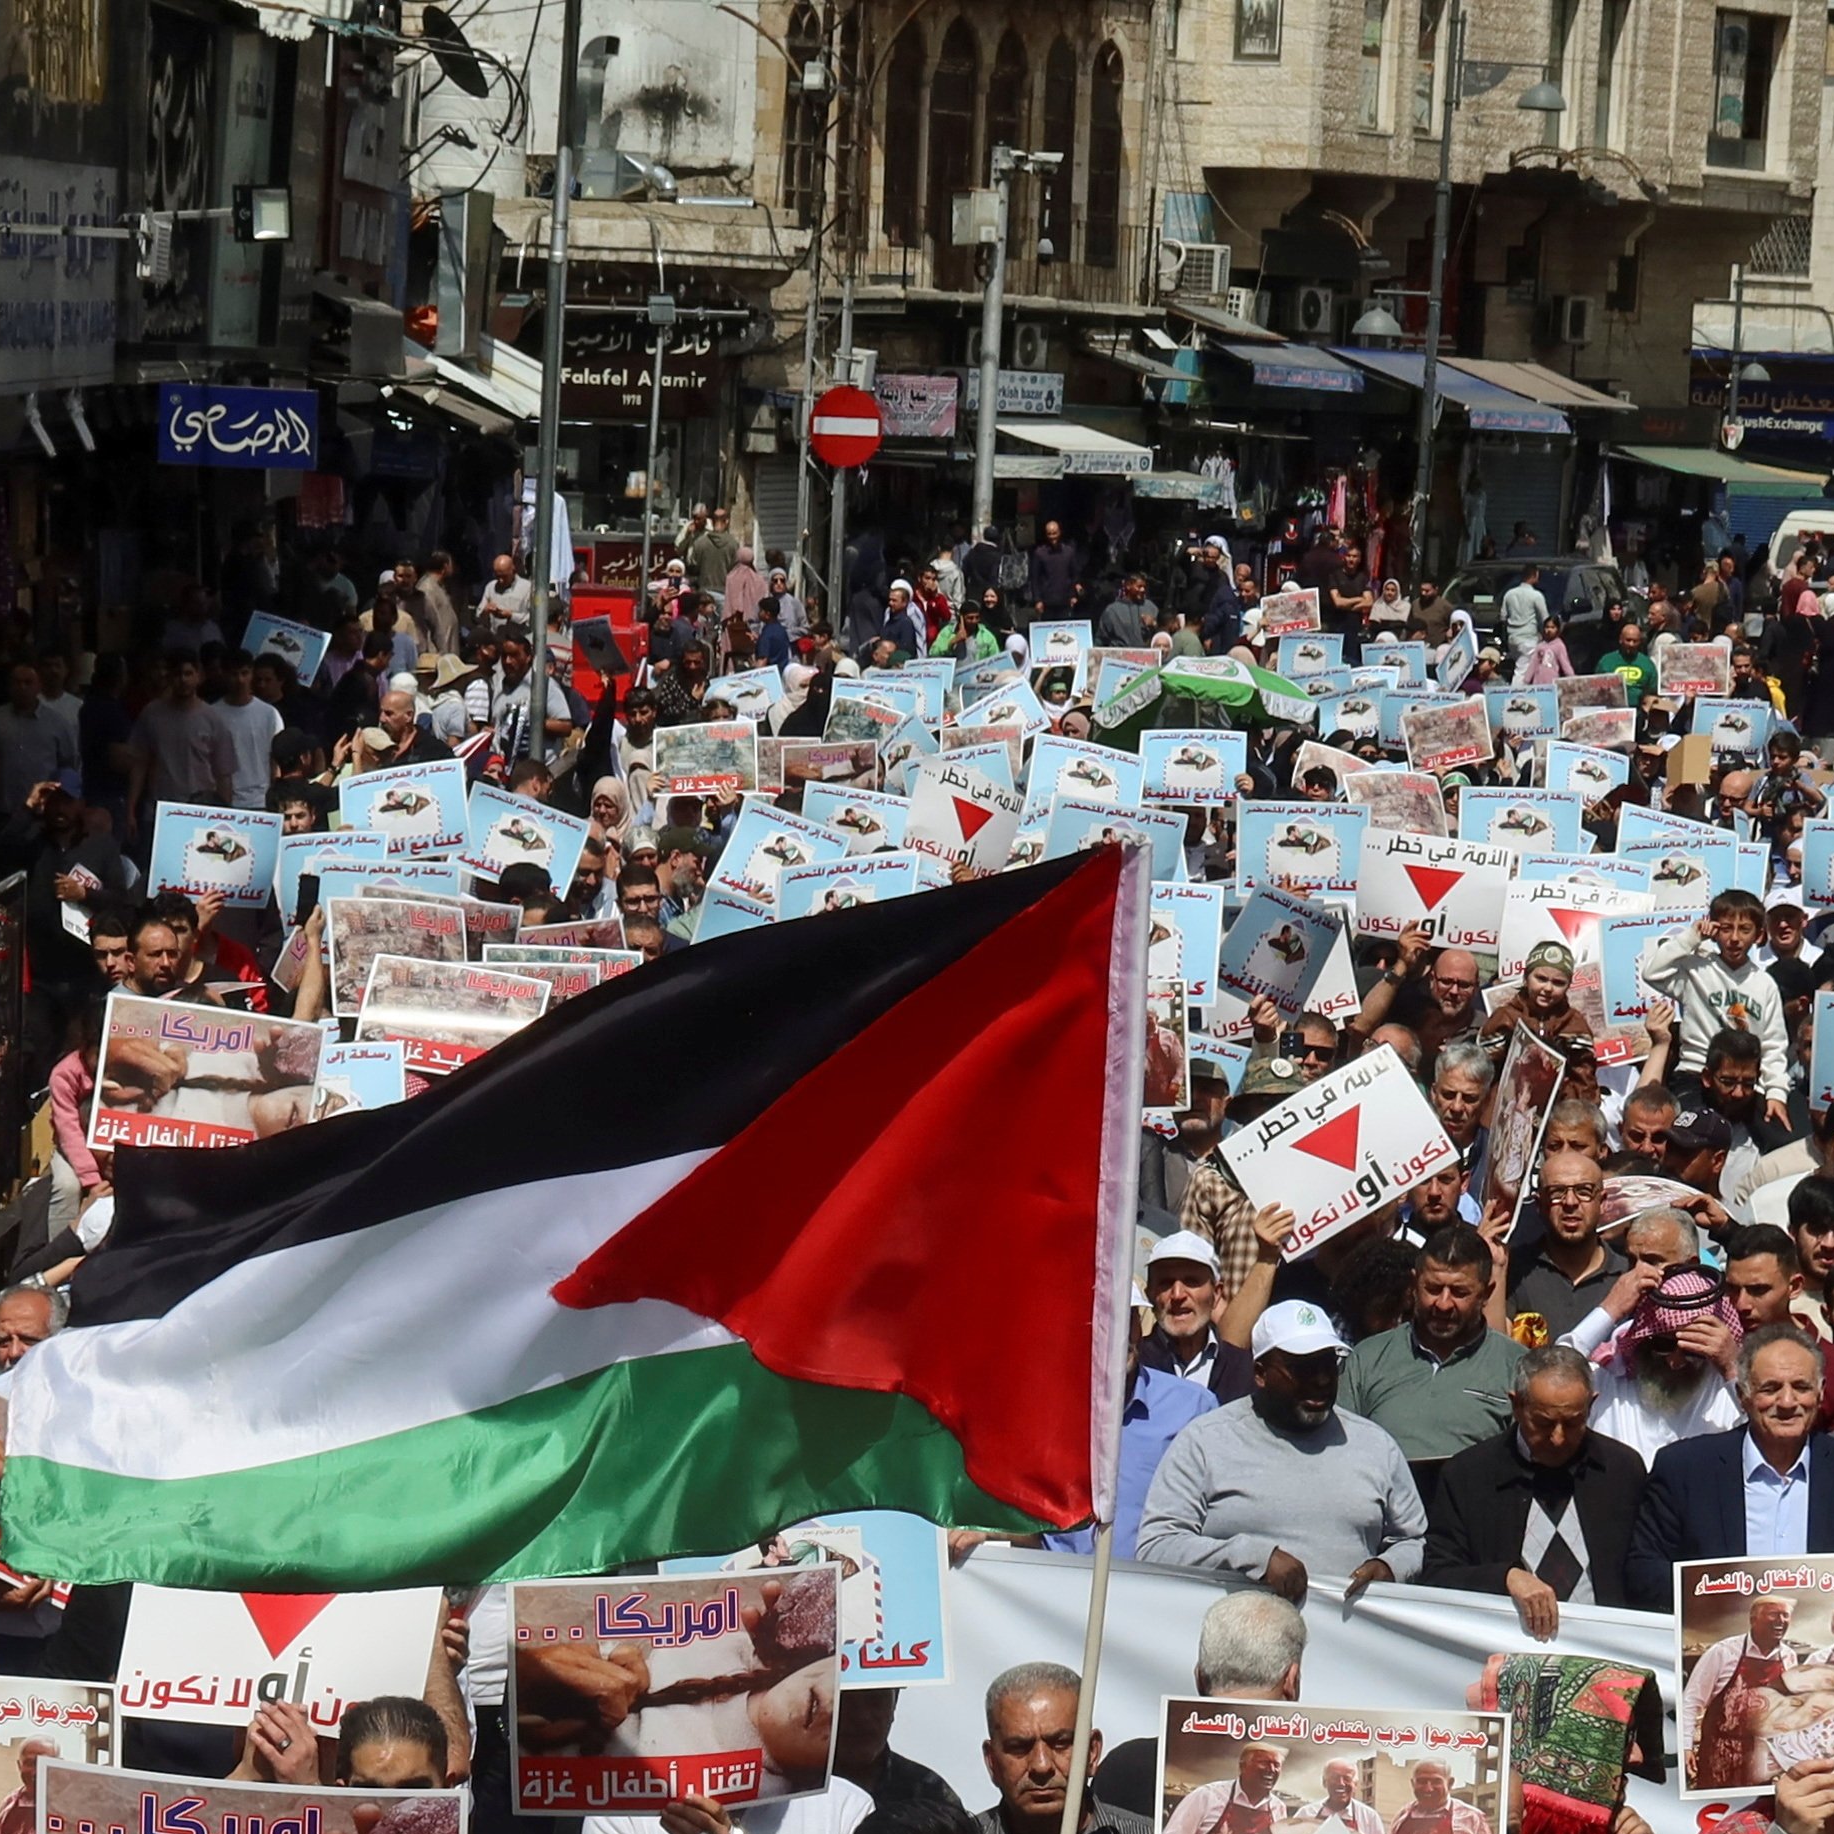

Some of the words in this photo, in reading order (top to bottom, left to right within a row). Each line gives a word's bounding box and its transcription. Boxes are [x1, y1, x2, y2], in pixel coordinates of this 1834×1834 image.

[566, 327, 632, 357] الأمير
[560, 368, 629, 387] Falafel
[638, 370, 707, 389] Aamir
[622, 395, 642, 406] 1978
[1021, 387, 1042, 400] bazar
[433, 832, 463, 847] كلنا
[1386, 835, 1423, 858] خطر
[1427, 844, 1457, 868] في
[1459, 845, 1508, 868] الأمة
[1530, 884, 1568, 903] خطر
[1358, 912, 1401, 935] نكون
[159, 1011, 256, 1053] امريكا
[326, 1049, 346, 1063] إلى
[349, 1048, 392, 1062] رسالة
[1389, 1135, 1452, 1188] نكون
[1355, 1155, 1390, 1207] أو
[1280, 1207, 1337, 1255] نكون
[859, 1639, 930, 1670] كلنا
[1181, 1710, 1247, 1742] والنساء
[1247, 1711, 1309, 1742] الأطفال
[1312, 1721, 1373, 1748] يقتلون
[1375, 1725, 1419, 1748] حرب
[1422, 1725, 1491, 1751] مجرموا
[522, 1769, 575, 1800] غزة
[585, 1760, 680, 1802] أطفال
[686, 1760, 758, 1801] تقتل
